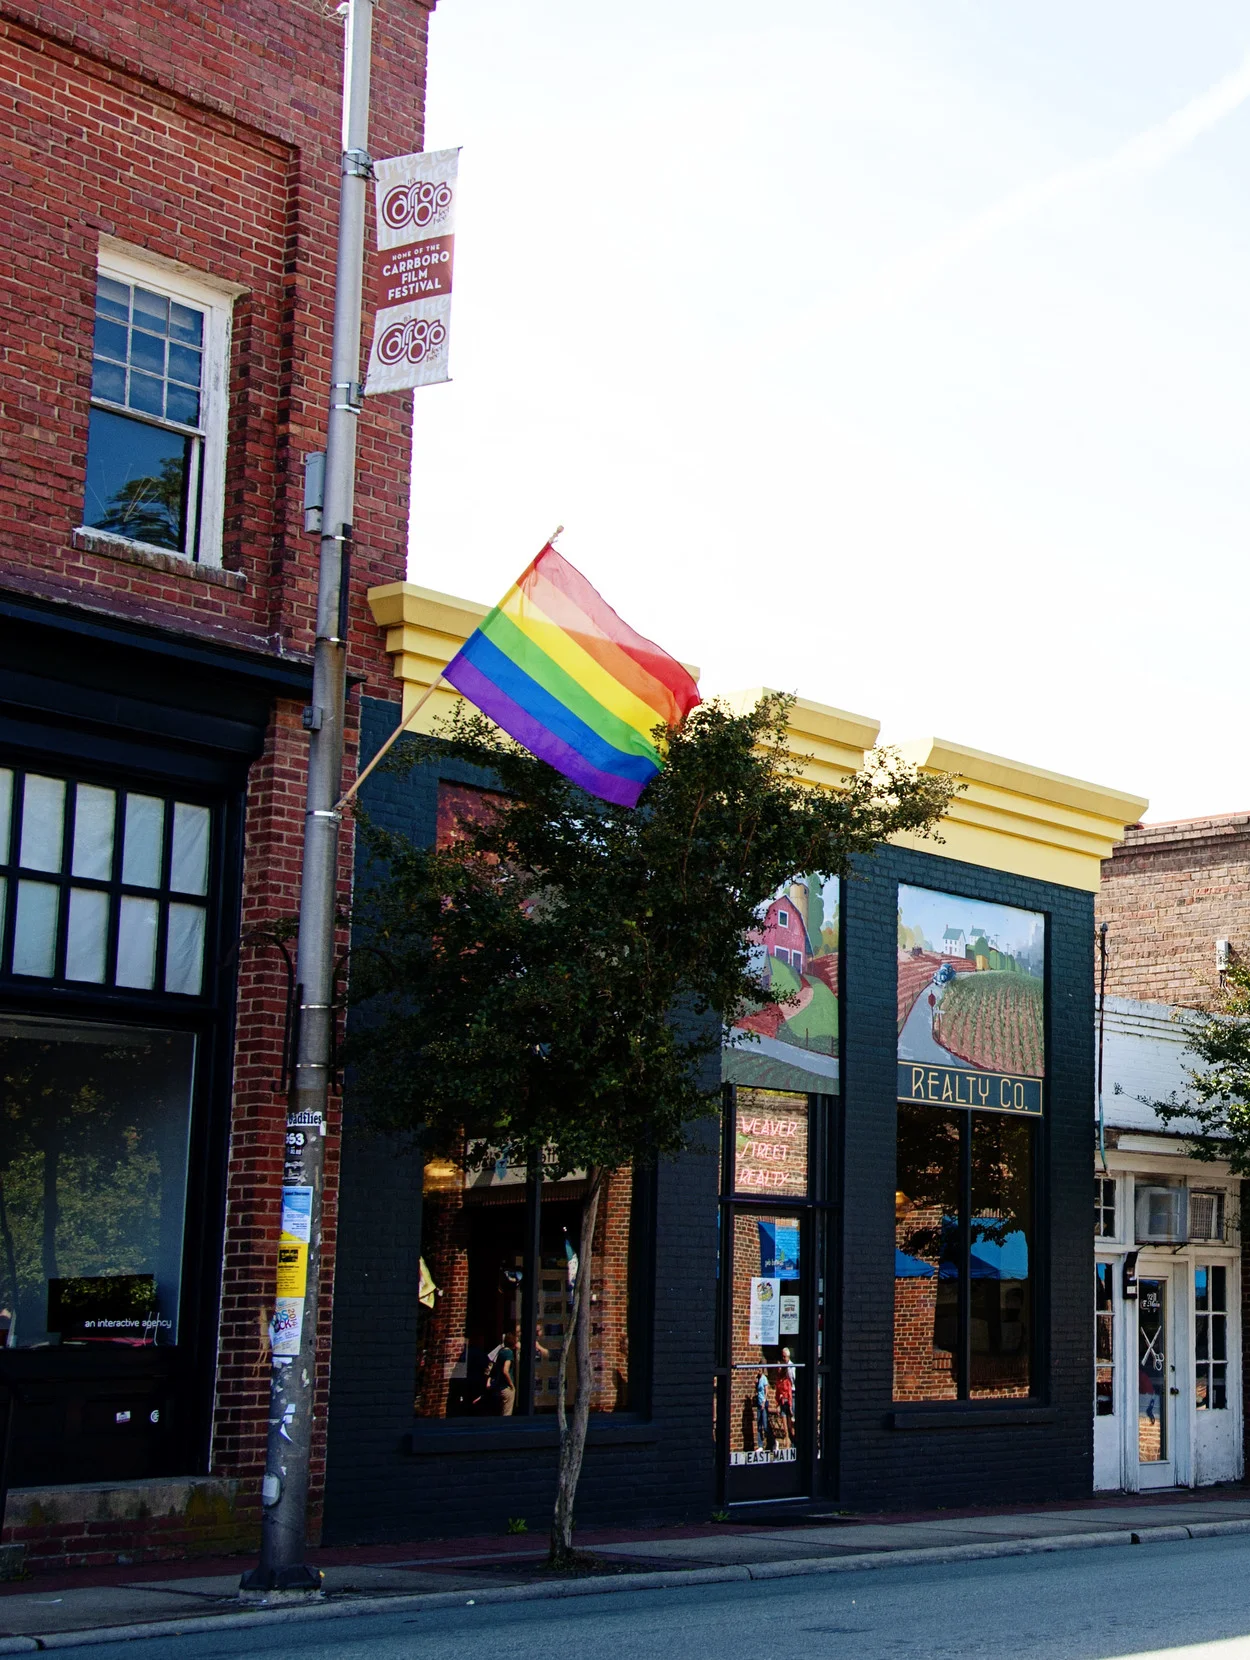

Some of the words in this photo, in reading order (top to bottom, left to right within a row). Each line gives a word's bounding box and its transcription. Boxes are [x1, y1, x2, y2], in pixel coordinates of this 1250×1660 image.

[392, 250, 412, 261] HOME
[413, 247, 424, 255] OF
[426, 243, 441, 252] THE
[382, 250, 450, 277] CARRBORO
[401, 267, 428, 285] FILM
[387, 277, 442, 301] FESTIVAL
[911, 1067, 990, 1106] REALTY
[1000, 1078, 1029, 1111] CO.
[740, 1115, 798, 1138] WEAVER
[735, 1140, 790, 1161] STREET
[738, 1168, 790, 1187] REALTY
[84, 1319, 95, 1328] an
[97, 1317, 140, 1328] interactive
[142, 1318, 172, 1329] agency
[747, 1450, 770, 1463] EAST
[773, 1448, 796, 1461] MAIN
